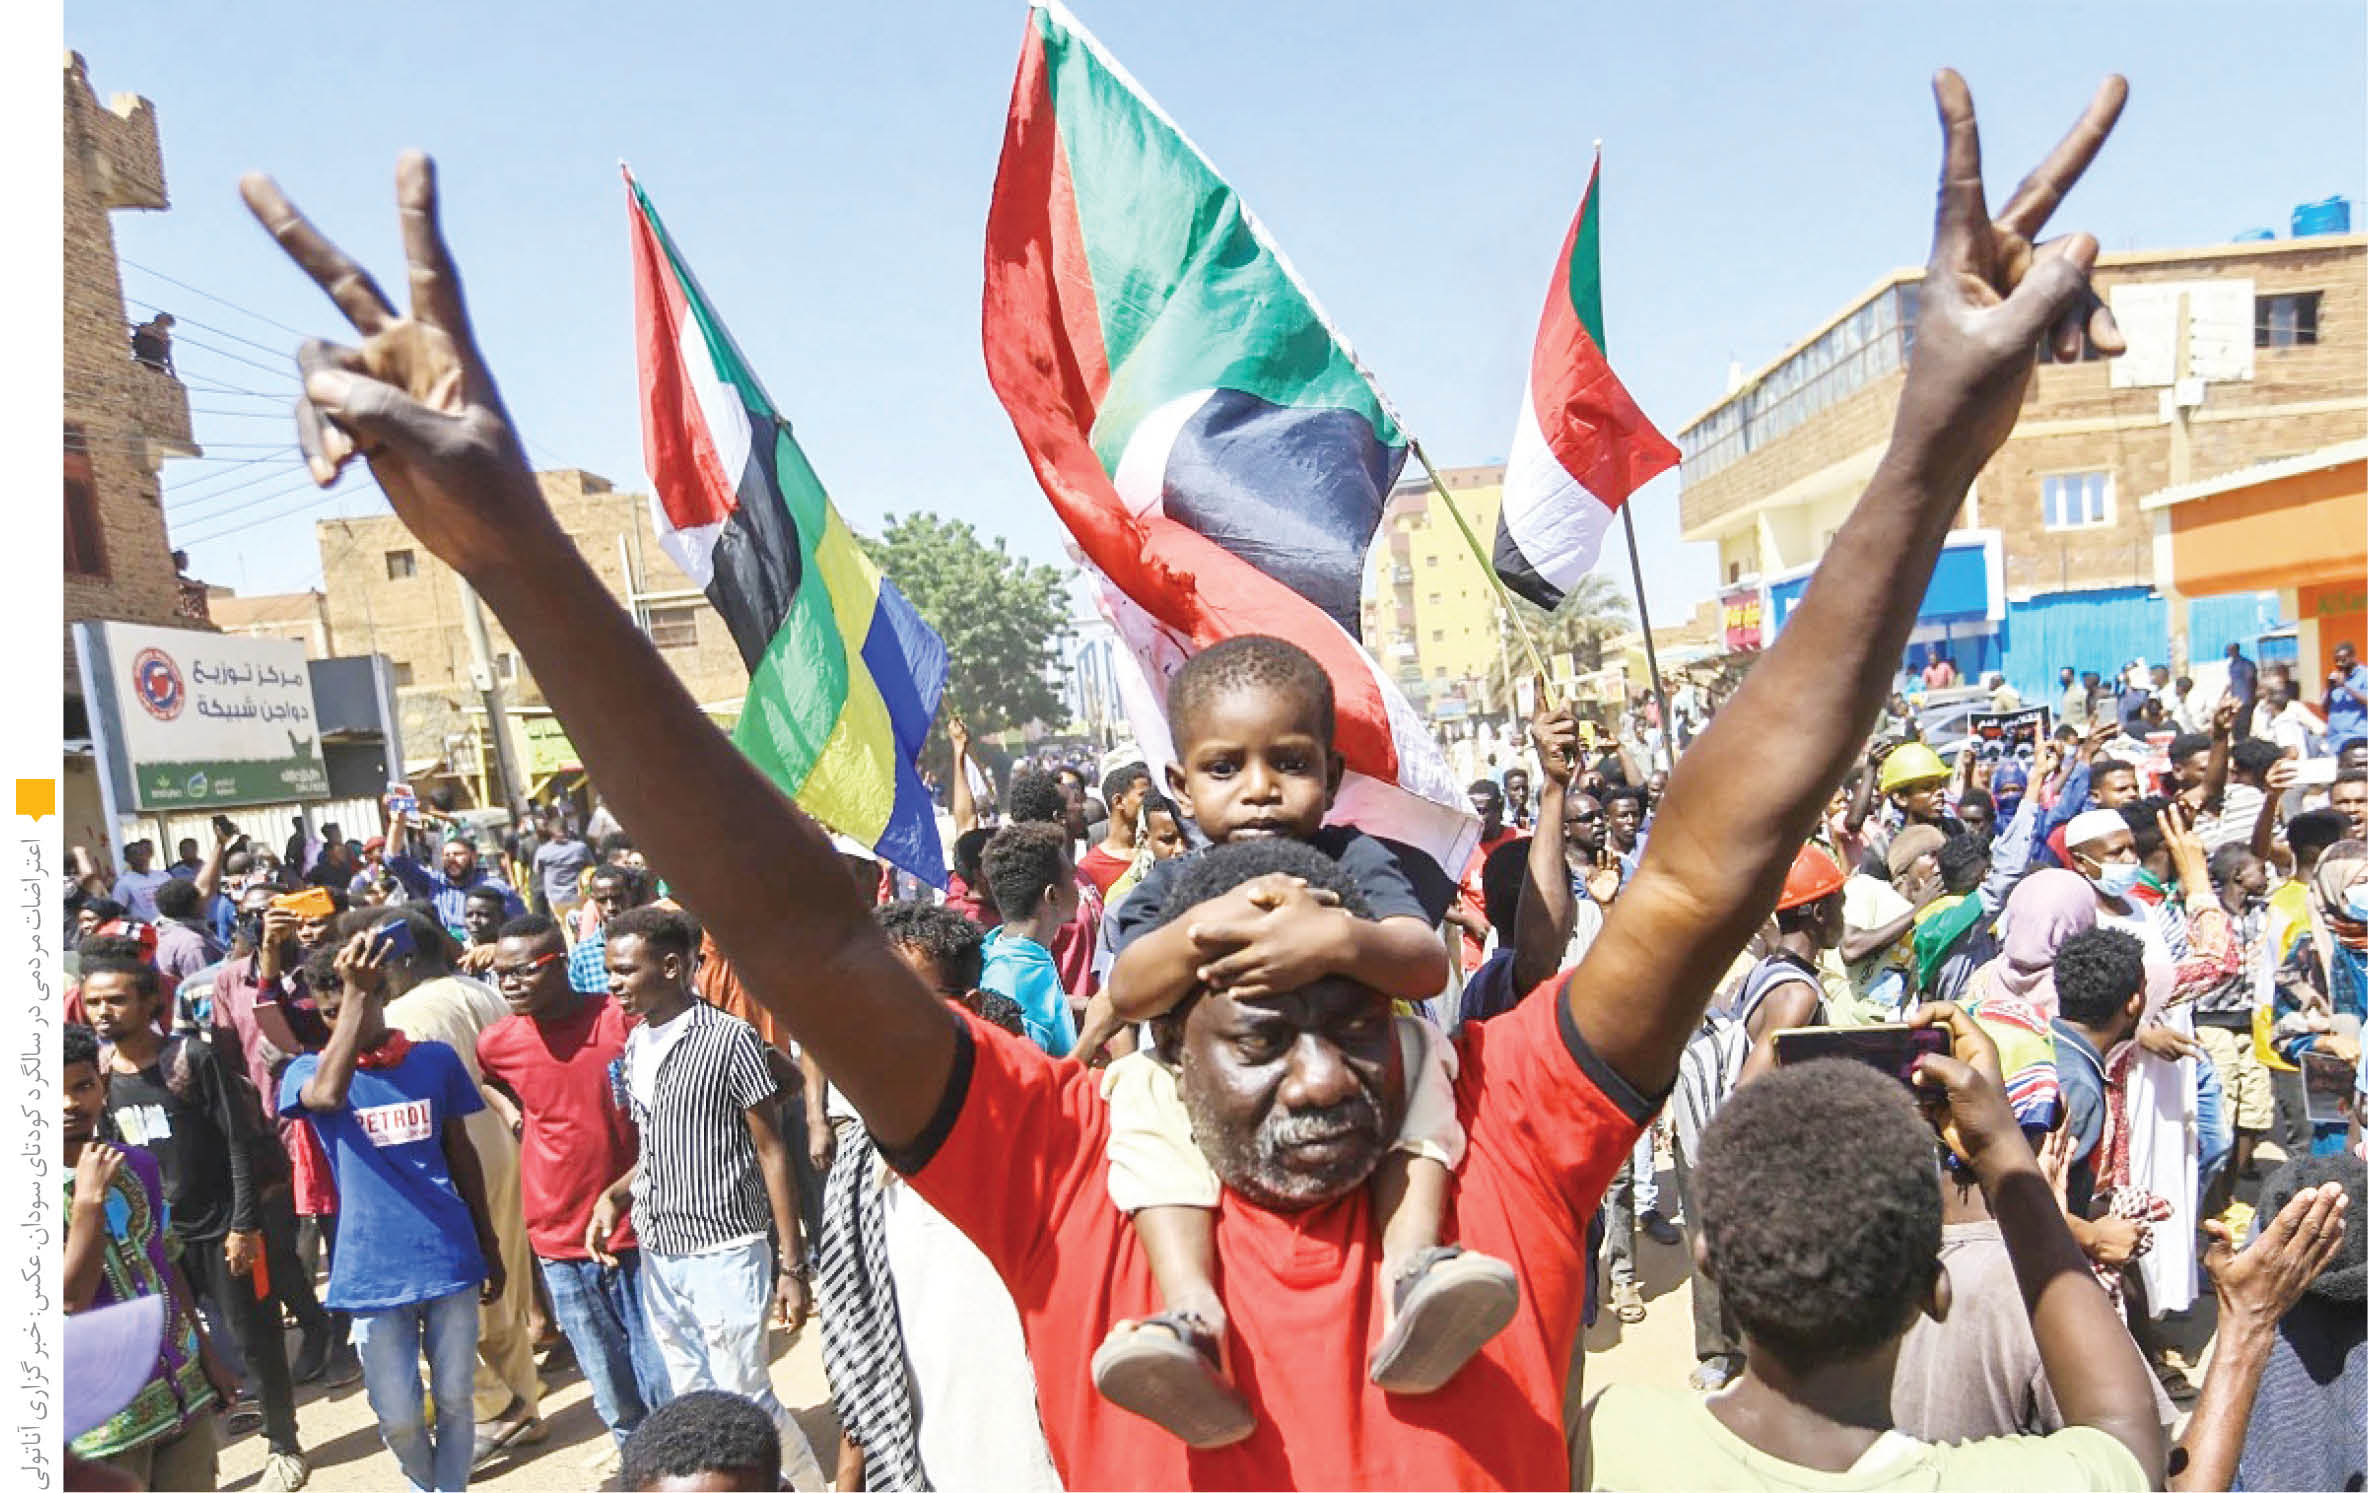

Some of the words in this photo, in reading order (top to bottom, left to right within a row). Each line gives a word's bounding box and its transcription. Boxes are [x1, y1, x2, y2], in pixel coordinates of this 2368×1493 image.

[192, 660, 252, 688] توزيع
[258, 665, 302, 688] مركز
[260, 702, 309, 724] دواجن
